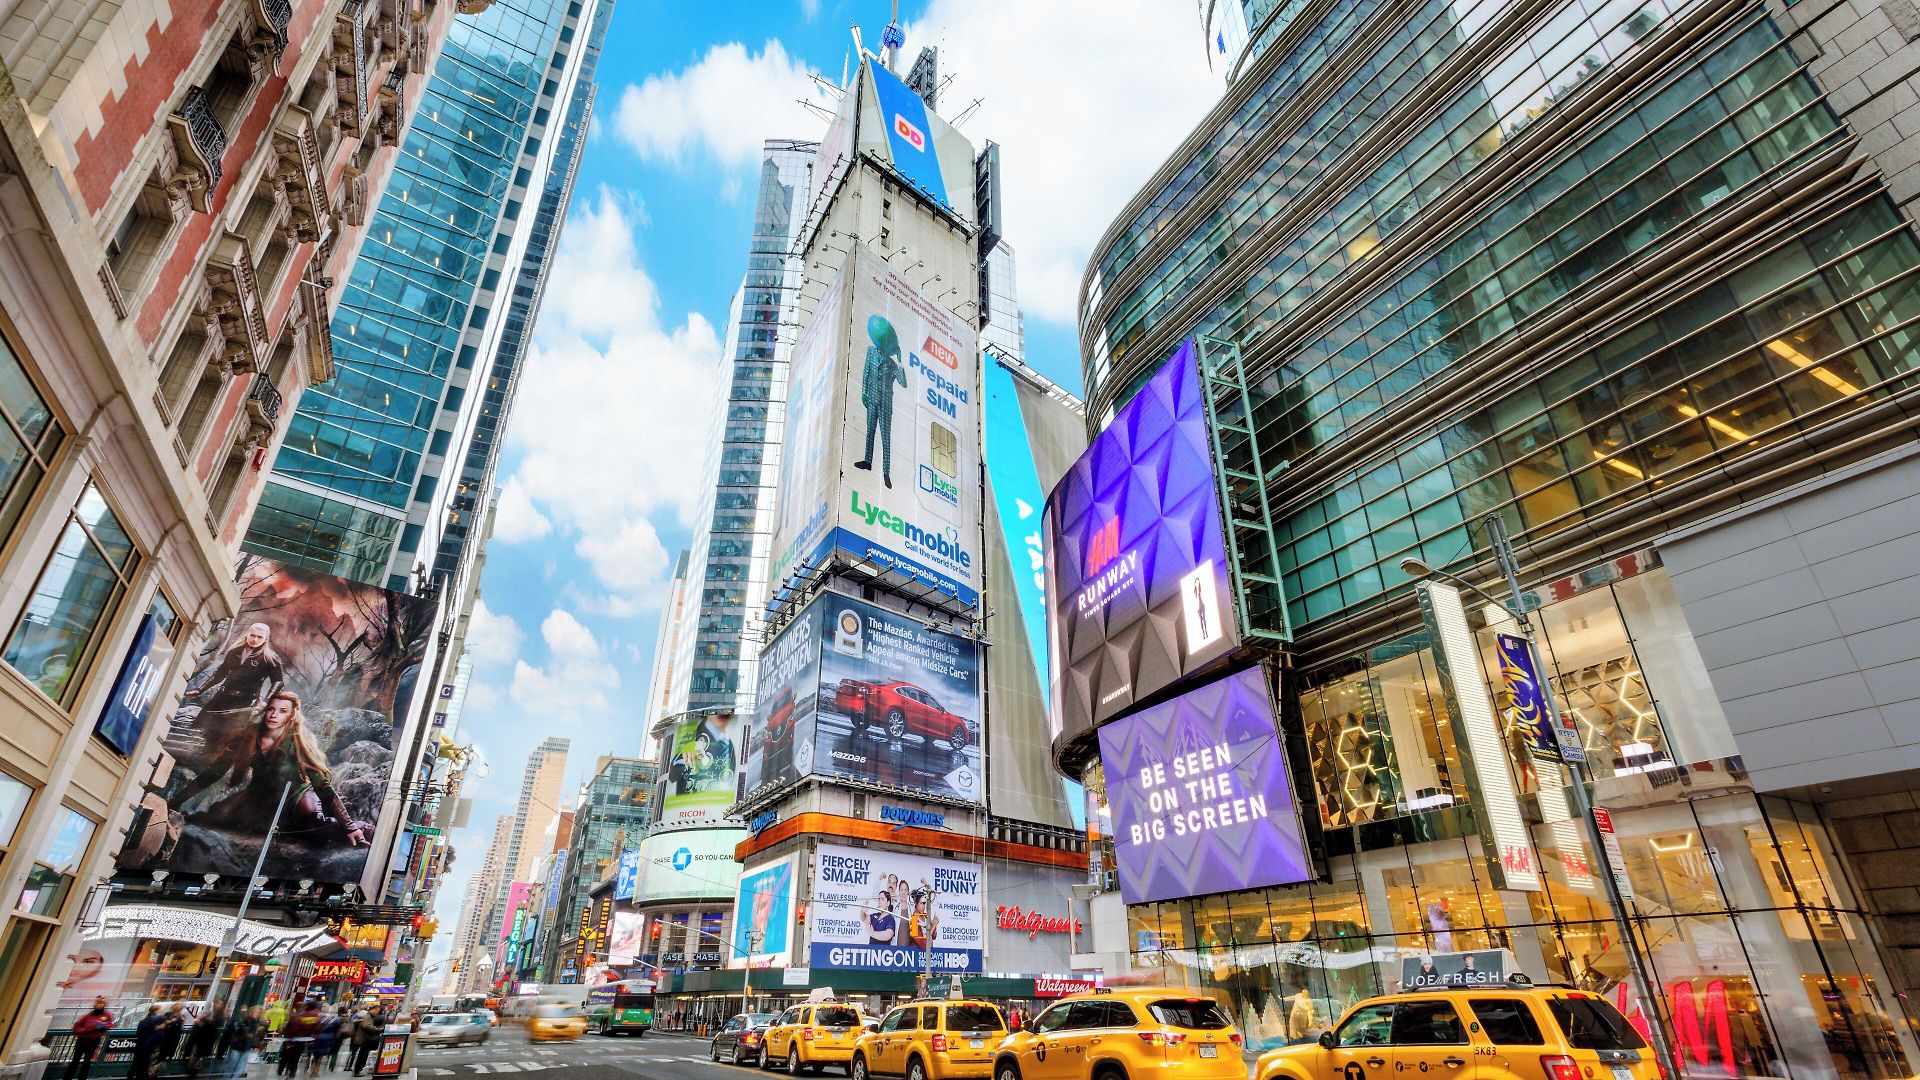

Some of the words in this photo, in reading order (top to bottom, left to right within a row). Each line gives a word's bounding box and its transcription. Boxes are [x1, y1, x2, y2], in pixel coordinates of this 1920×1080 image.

[898, 289, 909, 298] our
[883, 285, 895, 297] low
[896, 295, 911, 309] cost
[911, 305, 949, 337] international
[950, 335, 963, 348] calls
[920, 296, 950, 322] customers
[931, 341, 955, 366] new
[909, 351, 968, 405] Prepaid
[926, 387, 956, 419] SIM
[934, 473, 957, 496] Lyca
[934, 486, 957, 503] mobile
[851, 490, 971, 568] Lycamobile
[904, 540, 918, 554] Call
[919, 548, 931, 559] the
[931, 555, 949, 570] world
[949, 563, 959, 572] for
[1078, 549, 1137, 611] RUNWAY
[1084, 603, 1100, 619] TIMES
[1101, 586, 1121, 607] SQUARE
[1122, 576, 1134, 590] NYC
[762, 647, 777, 680] THE
[776, 613, 812, 666] OWNERS
[868, 616, 883, 630] The
[916, 633, 946, 651] Awarded
[948, 643, 960, 655] the
[867, 641, 894, 658] Appeal
[895, 650, 921, 667] among
[921, 658, 948, 674] Midsize
[903, 640, 930, 659] Ranked
[931, 649, 956, 665] Vehicle
[123, 655, 158, 719] GAP
[441, 686, 451, 697] C
[433, 715, 444, 726] H
[1558, 729, 1575, 737] NYPD
[1140, 763, 1166, 789] BE
[1173, 742, 1232, 778] SEEN
[1150, 787, 1179, 813] ON
[1186, 773, 1233, 803] THE
[679, 810, 706, 818] RICOH
[1131, 819, 1165, 846] BIG
[1173, 794, 1268, 836] SCREEN
[653, 856, 671, 864] CHASE
[600, 897, 611, 929] VICTORY
[943, 904, 980, 912] PHENOMENAL
[507, 908, 524, 963] REGAL
[596, 932, 605, 948] NEW
[817, 926, 837, 934] VERY
[693, 953, 719, 961] CHASE
[918, 952, 943, 960] SUDAYS
[944, 952, 969, 969] HBO
[1036, 979, 1090, 996] Walgreens
[1406, 975, 1435, 987] JOE
[1443, 971, 1499, 985] FRESH
[383, 1041, 405, 1053] JERSEY
[1475, 1046, 1497, 1056] 5K83
[383, 1055, 400, 1065] BOYS
